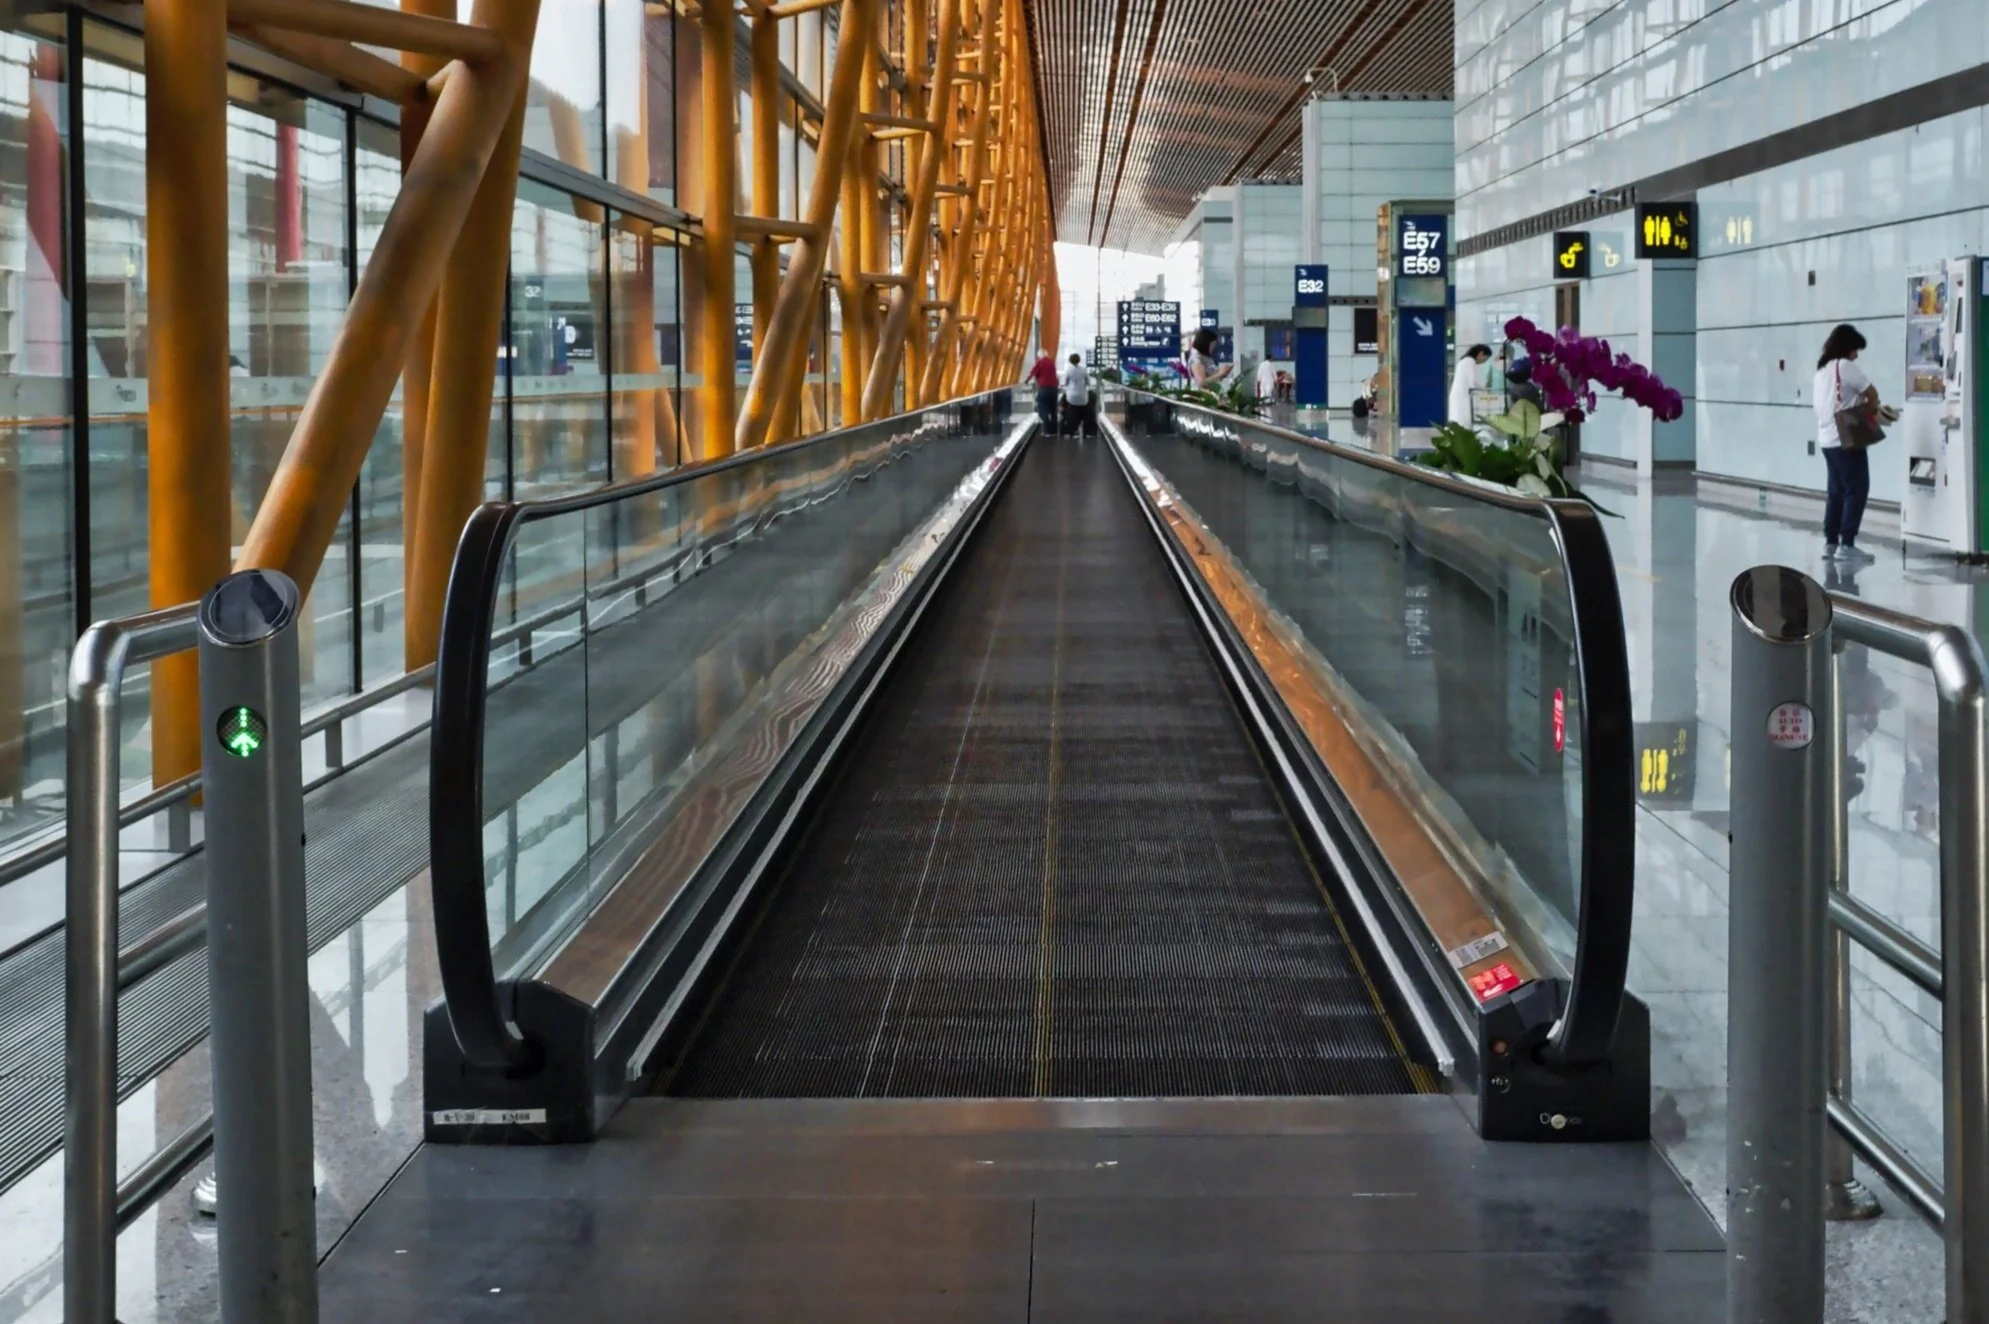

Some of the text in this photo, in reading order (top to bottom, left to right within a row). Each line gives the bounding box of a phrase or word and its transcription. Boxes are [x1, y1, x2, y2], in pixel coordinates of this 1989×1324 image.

[1403, 231, 1441, 250] E57
[1403, 255, 1441, 274] E59
[1298, 279, 1324, 293] E32
